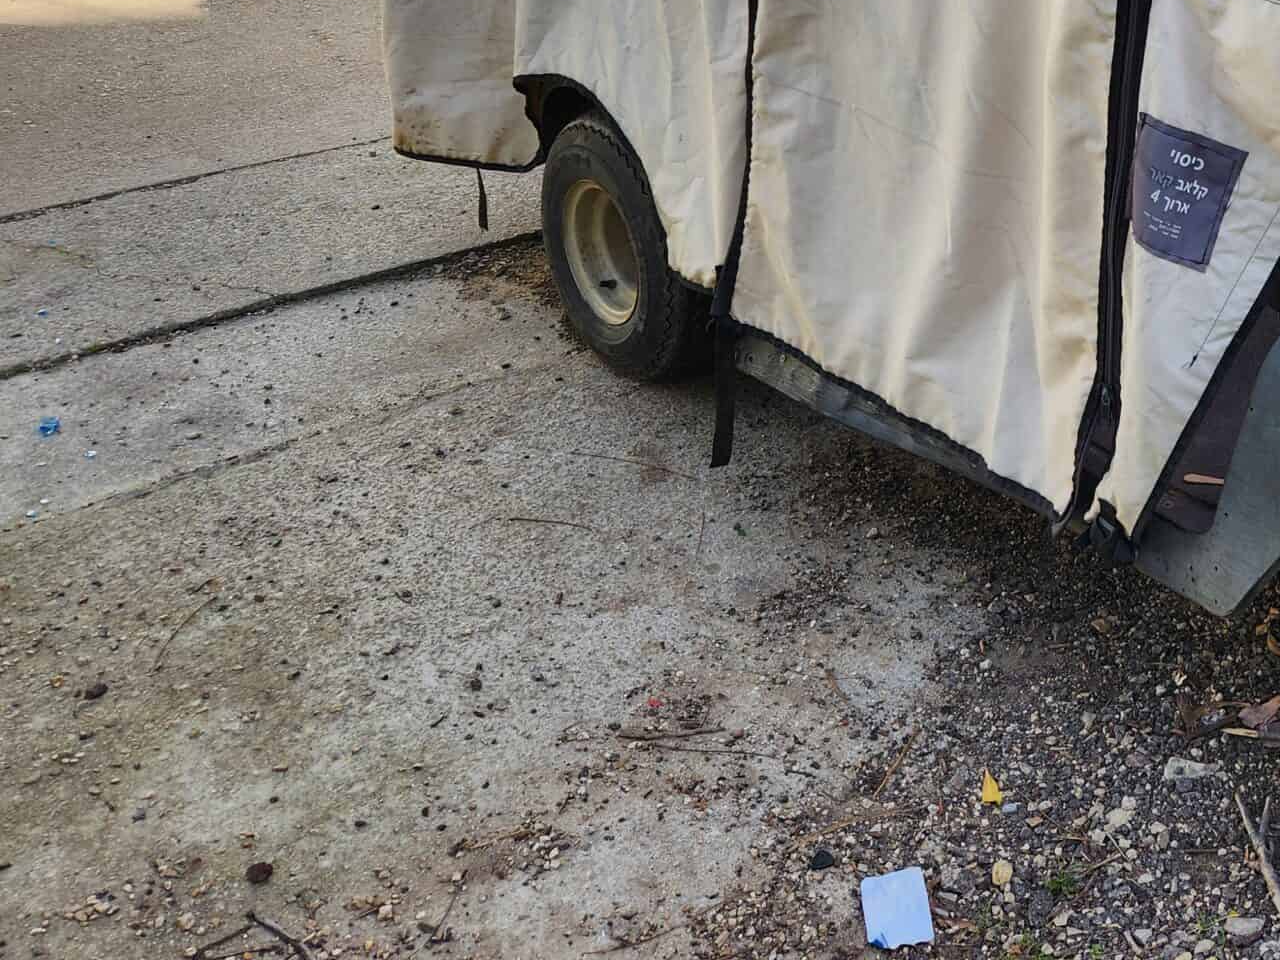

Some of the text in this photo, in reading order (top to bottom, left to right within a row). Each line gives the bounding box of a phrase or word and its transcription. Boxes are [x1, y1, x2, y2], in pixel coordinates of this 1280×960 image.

[1170, 149, 1205, 171] כיסוי
[1149, 167, 1209, 201] קלאב קאר
[1150, 188, 1191, 214] ארוך 4
